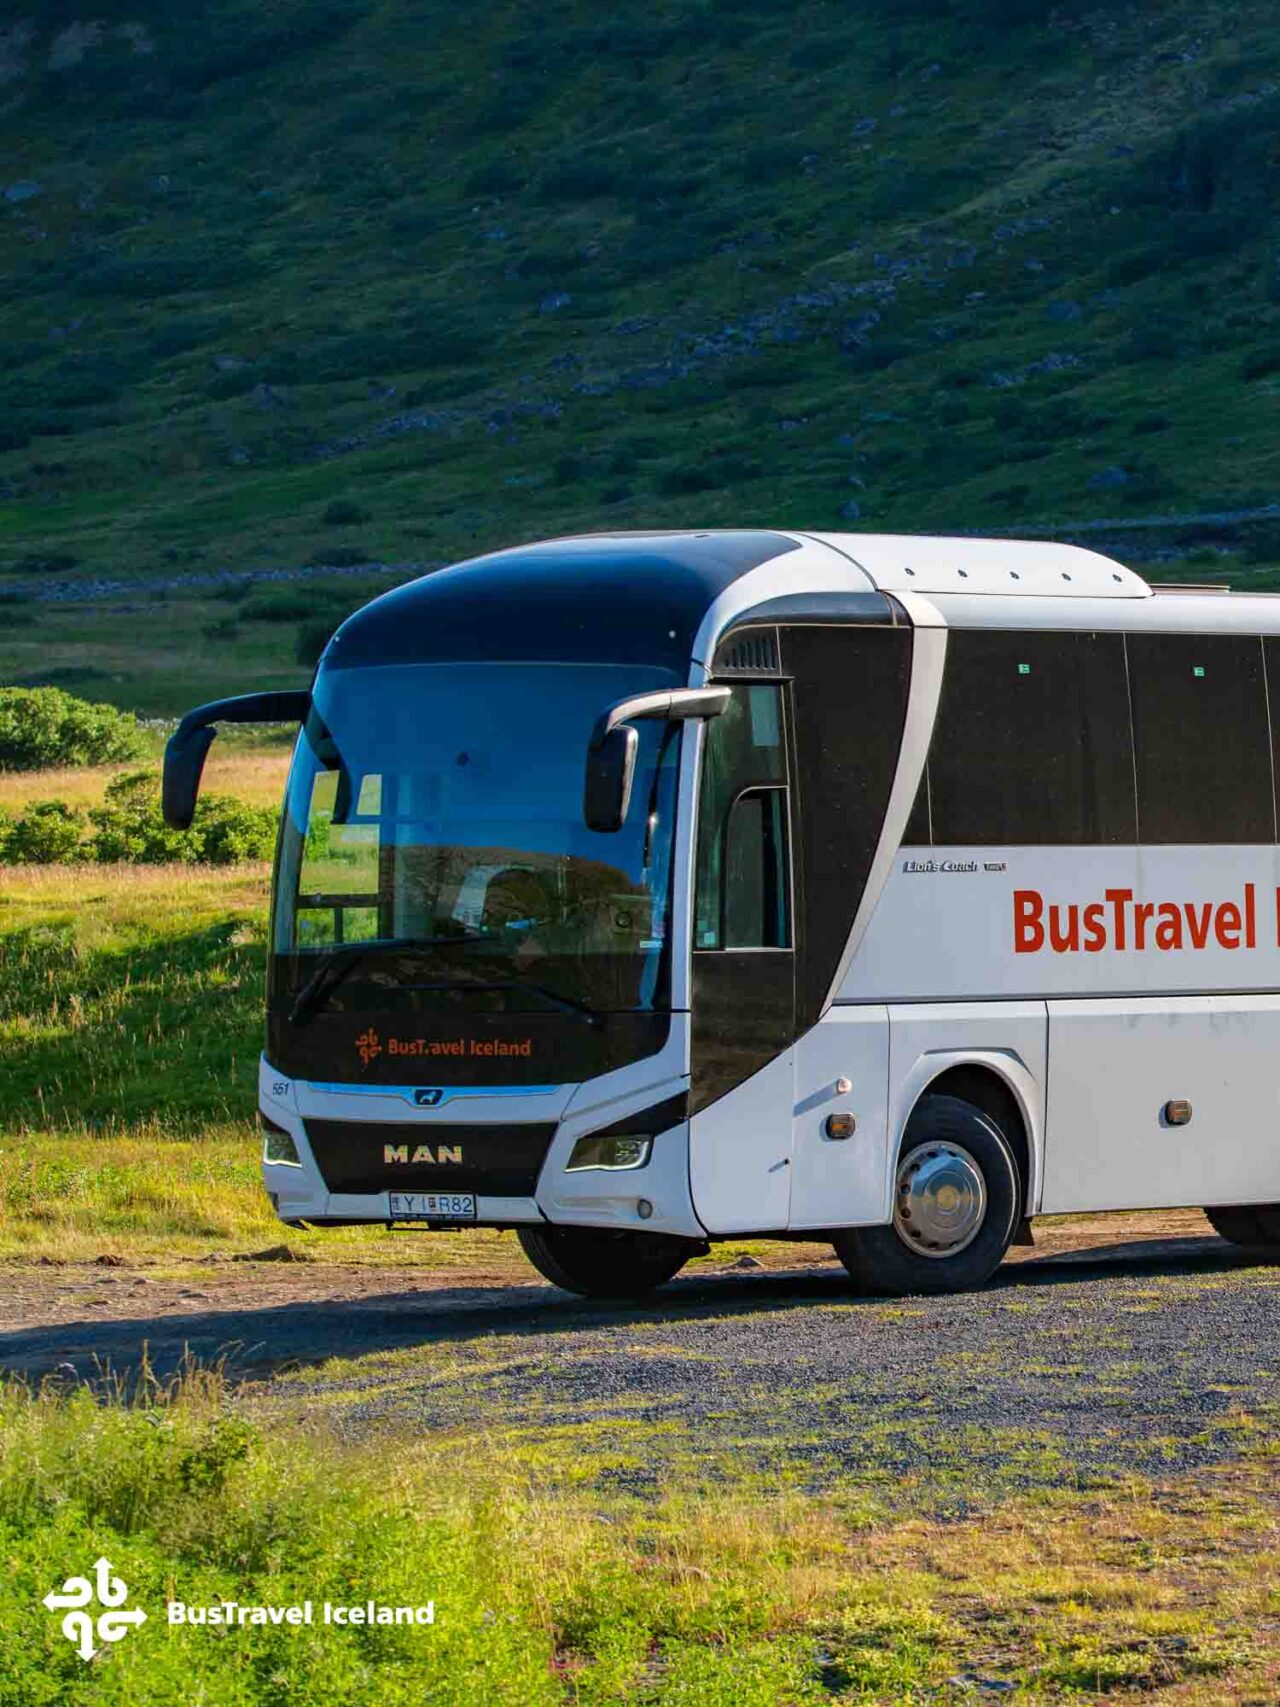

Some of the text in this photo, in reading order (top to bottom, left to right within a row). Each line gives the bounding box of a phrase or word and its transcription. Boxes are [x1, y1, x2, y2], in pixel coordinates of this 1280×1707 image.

[1012, 883, 1257, 954] BusTravel
[470, 1039, 532, 1056] Iceland
[272, 1082, 289, 1097] 551
[384, 1144, 463, 1164] MAN
